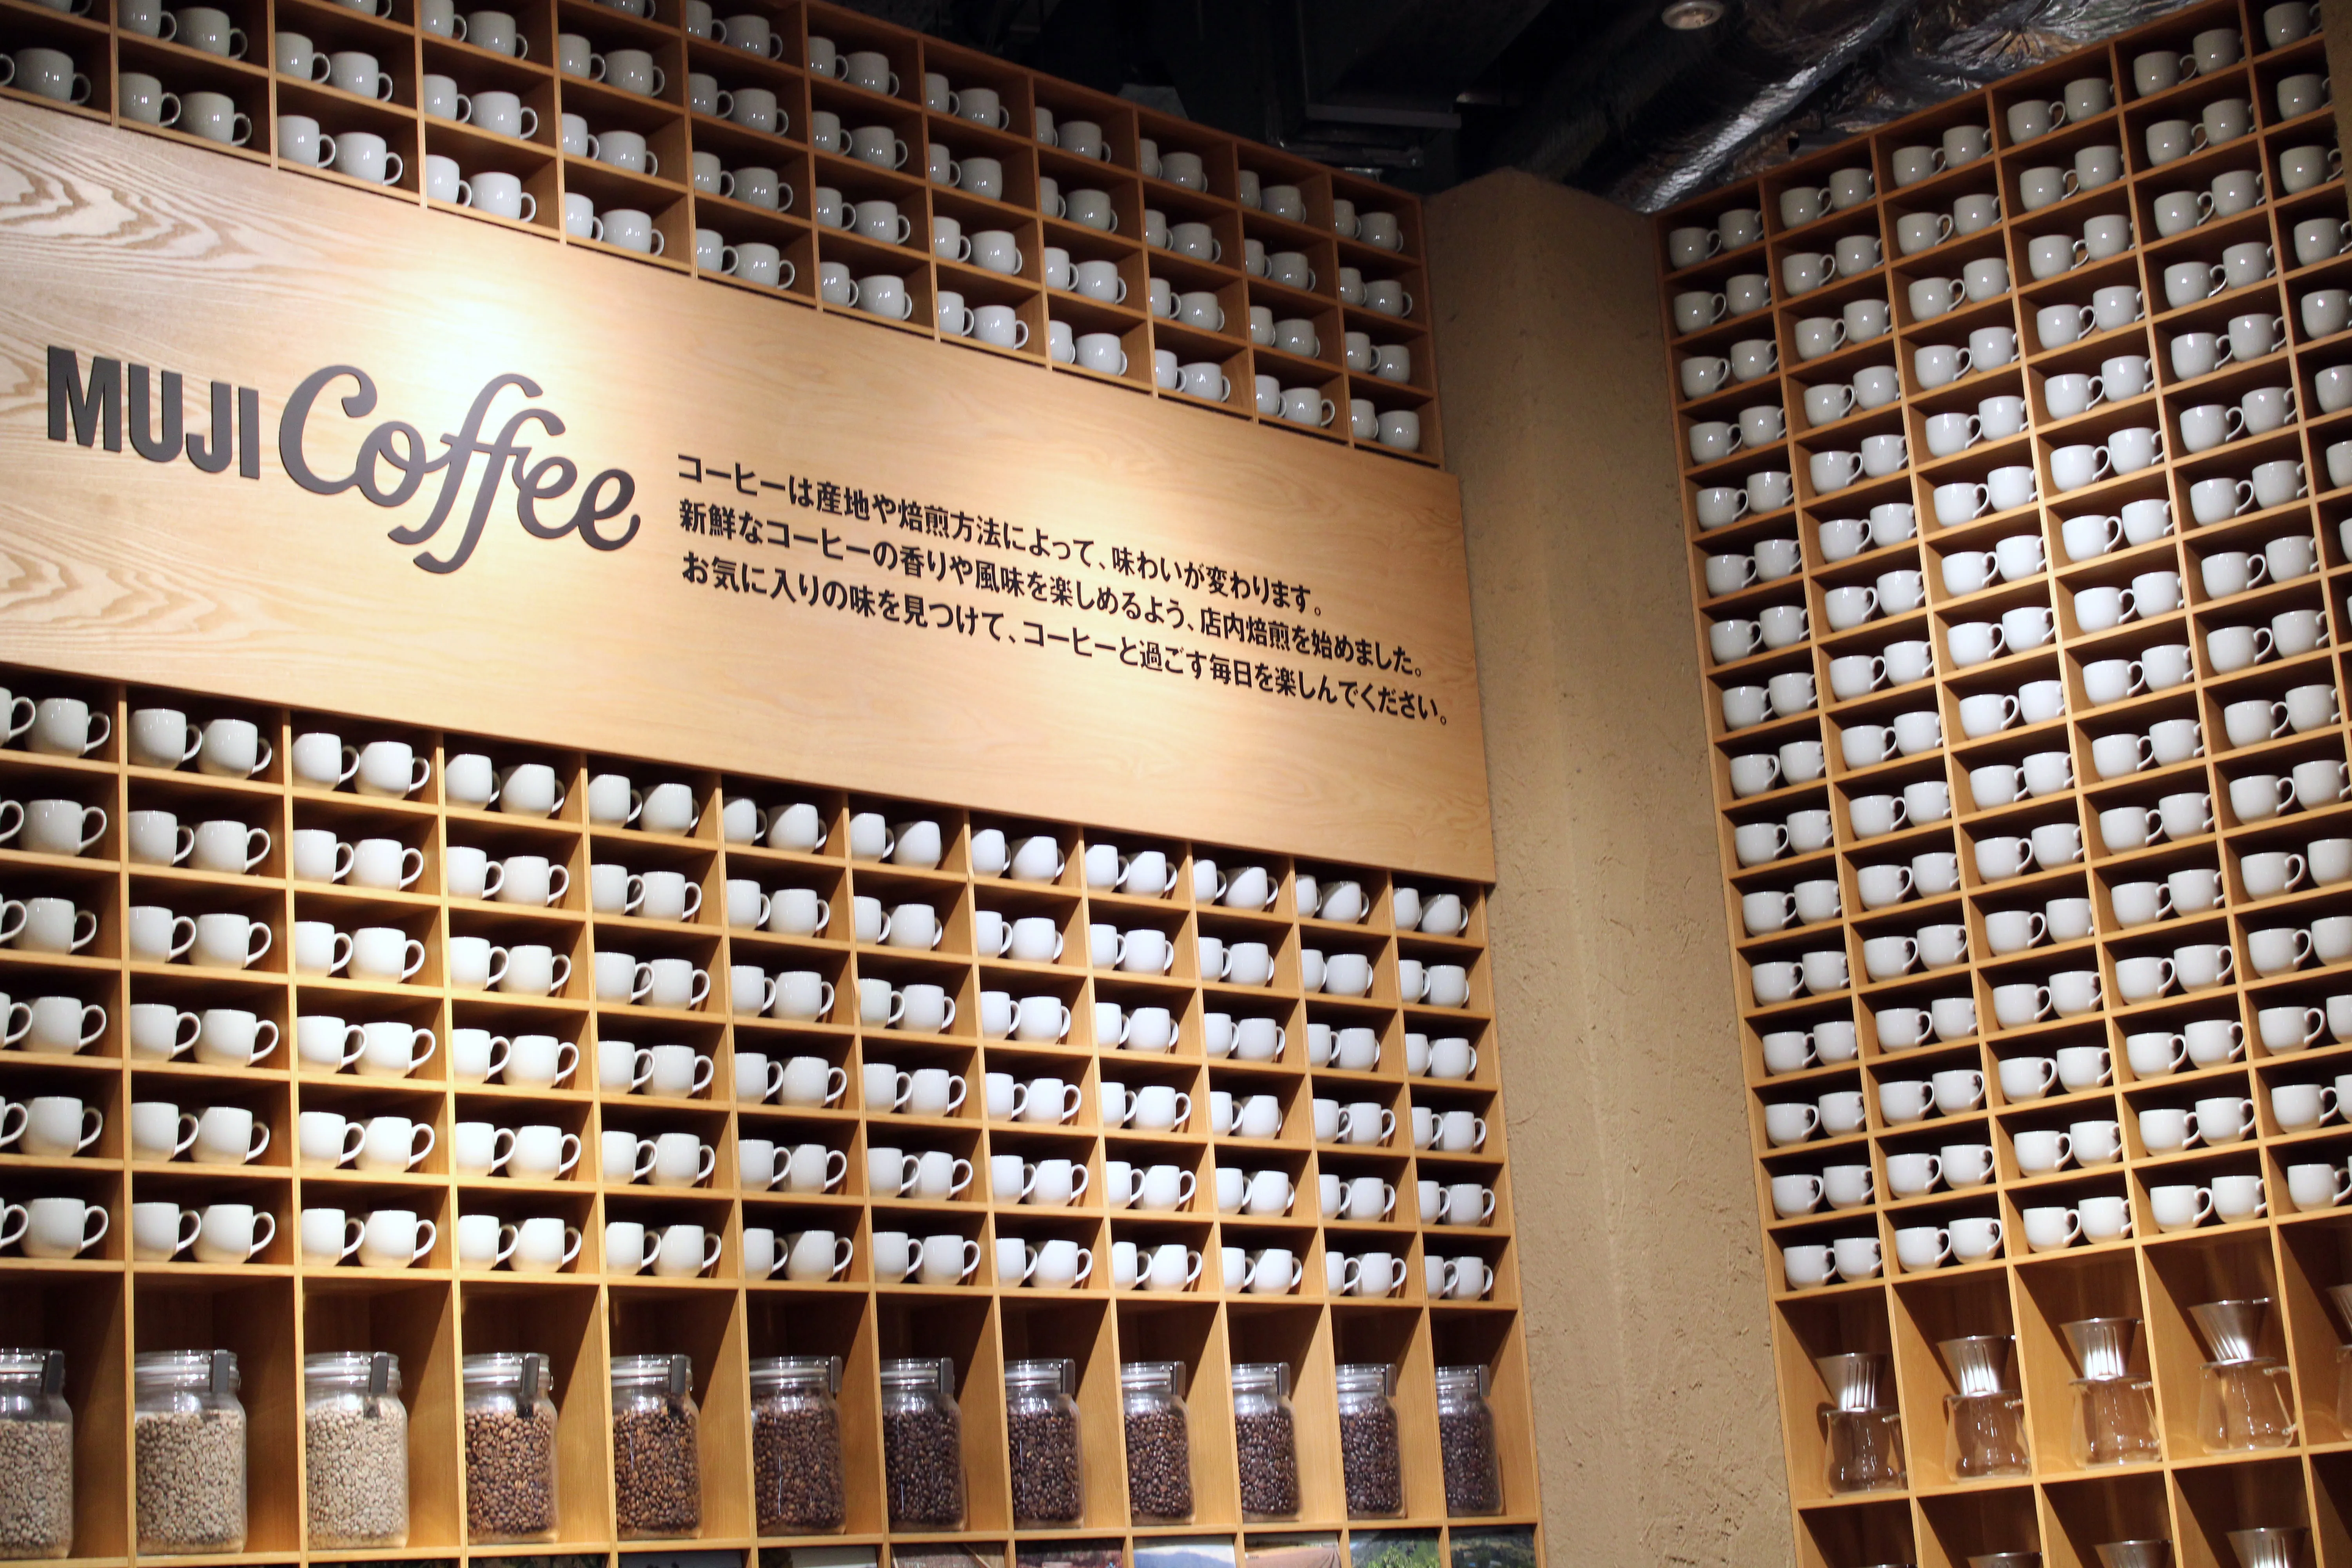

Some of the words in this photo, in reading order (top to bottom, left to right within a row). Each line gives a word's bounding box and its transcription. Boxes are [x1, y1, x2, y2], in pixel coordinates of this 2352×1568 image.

[47, 345, 260, 479] MUJI
[279, 364, 641, 574] Coffee
[678, 453, 1321, 617] コーヒーは産地や焙煎方法によって、味わいが変わります。
[679, 498, 1422, 677] 新鮮なコーヒーの香りや風味を楽しめるよう、店内焙煎を始めました。
[682, 551, 1447, 726] お気に入りの味を見つけて、コーヒーと過ごす毎日を楽しんでください。
